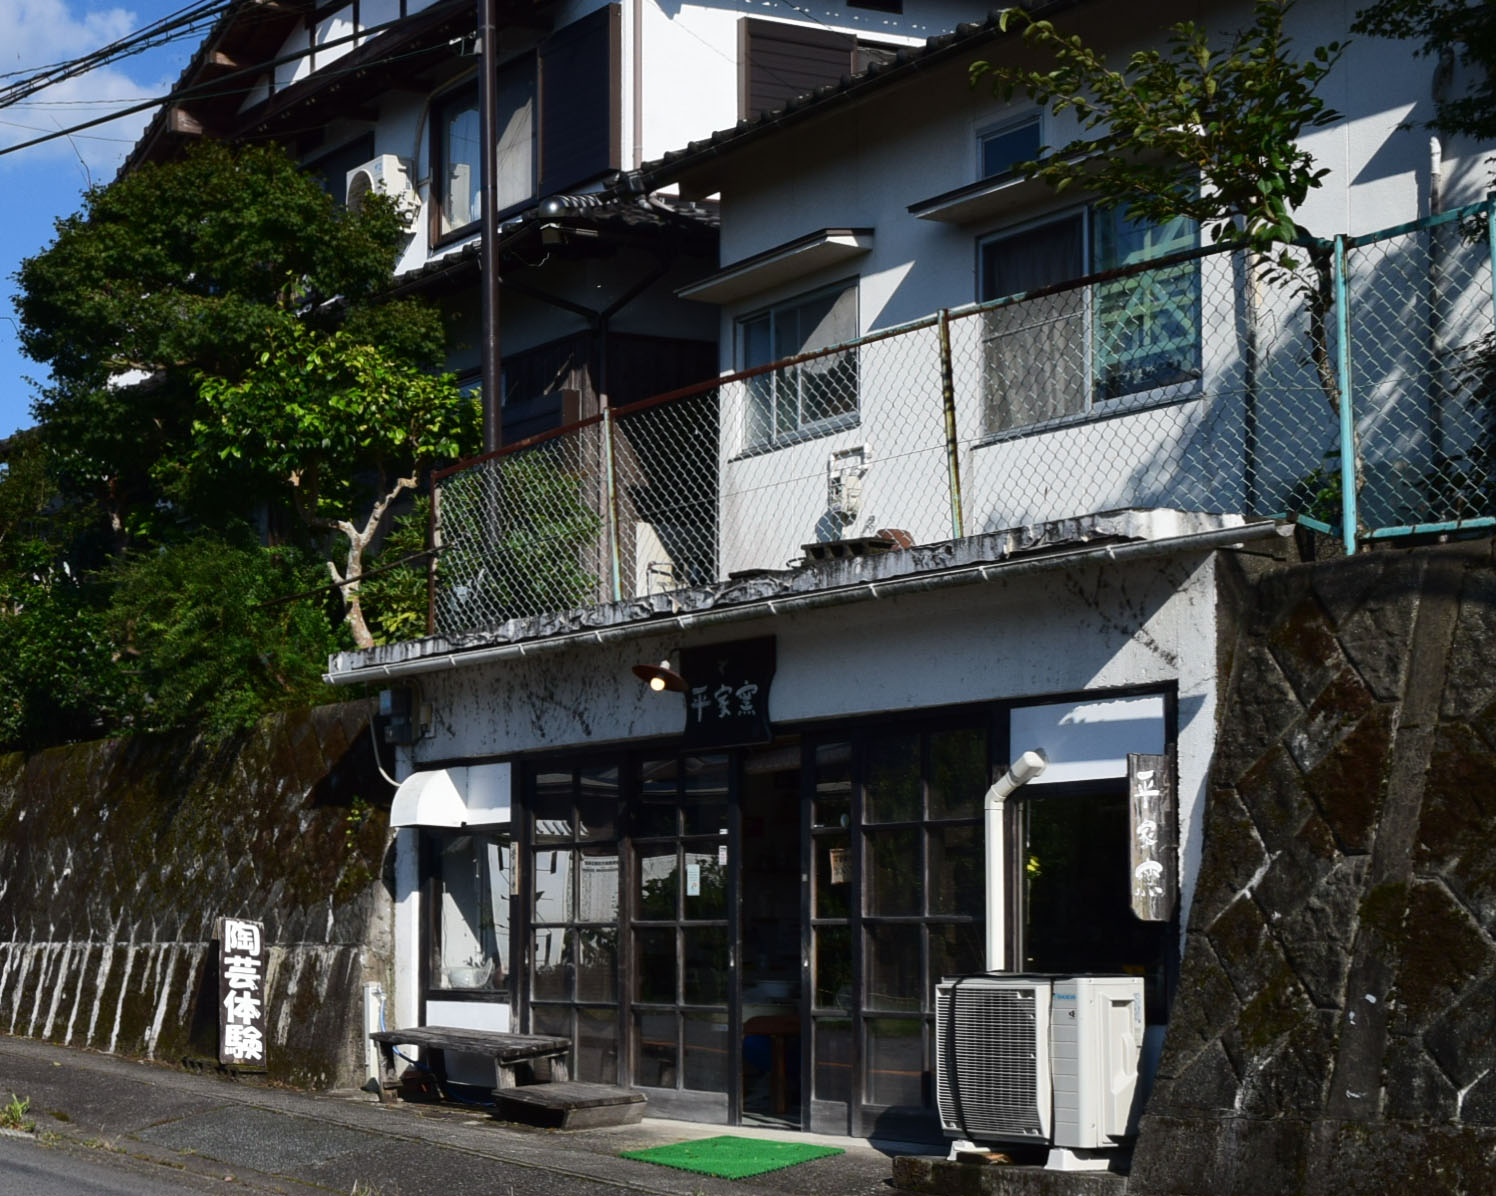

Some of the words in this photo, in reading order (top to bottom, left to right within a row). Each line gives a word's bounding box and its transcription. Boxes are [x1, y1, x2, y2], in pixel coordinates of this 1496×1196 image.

[690, 679, 759, 723] 平家窯
[223, 919, 263, 1061] 陶芸体験
